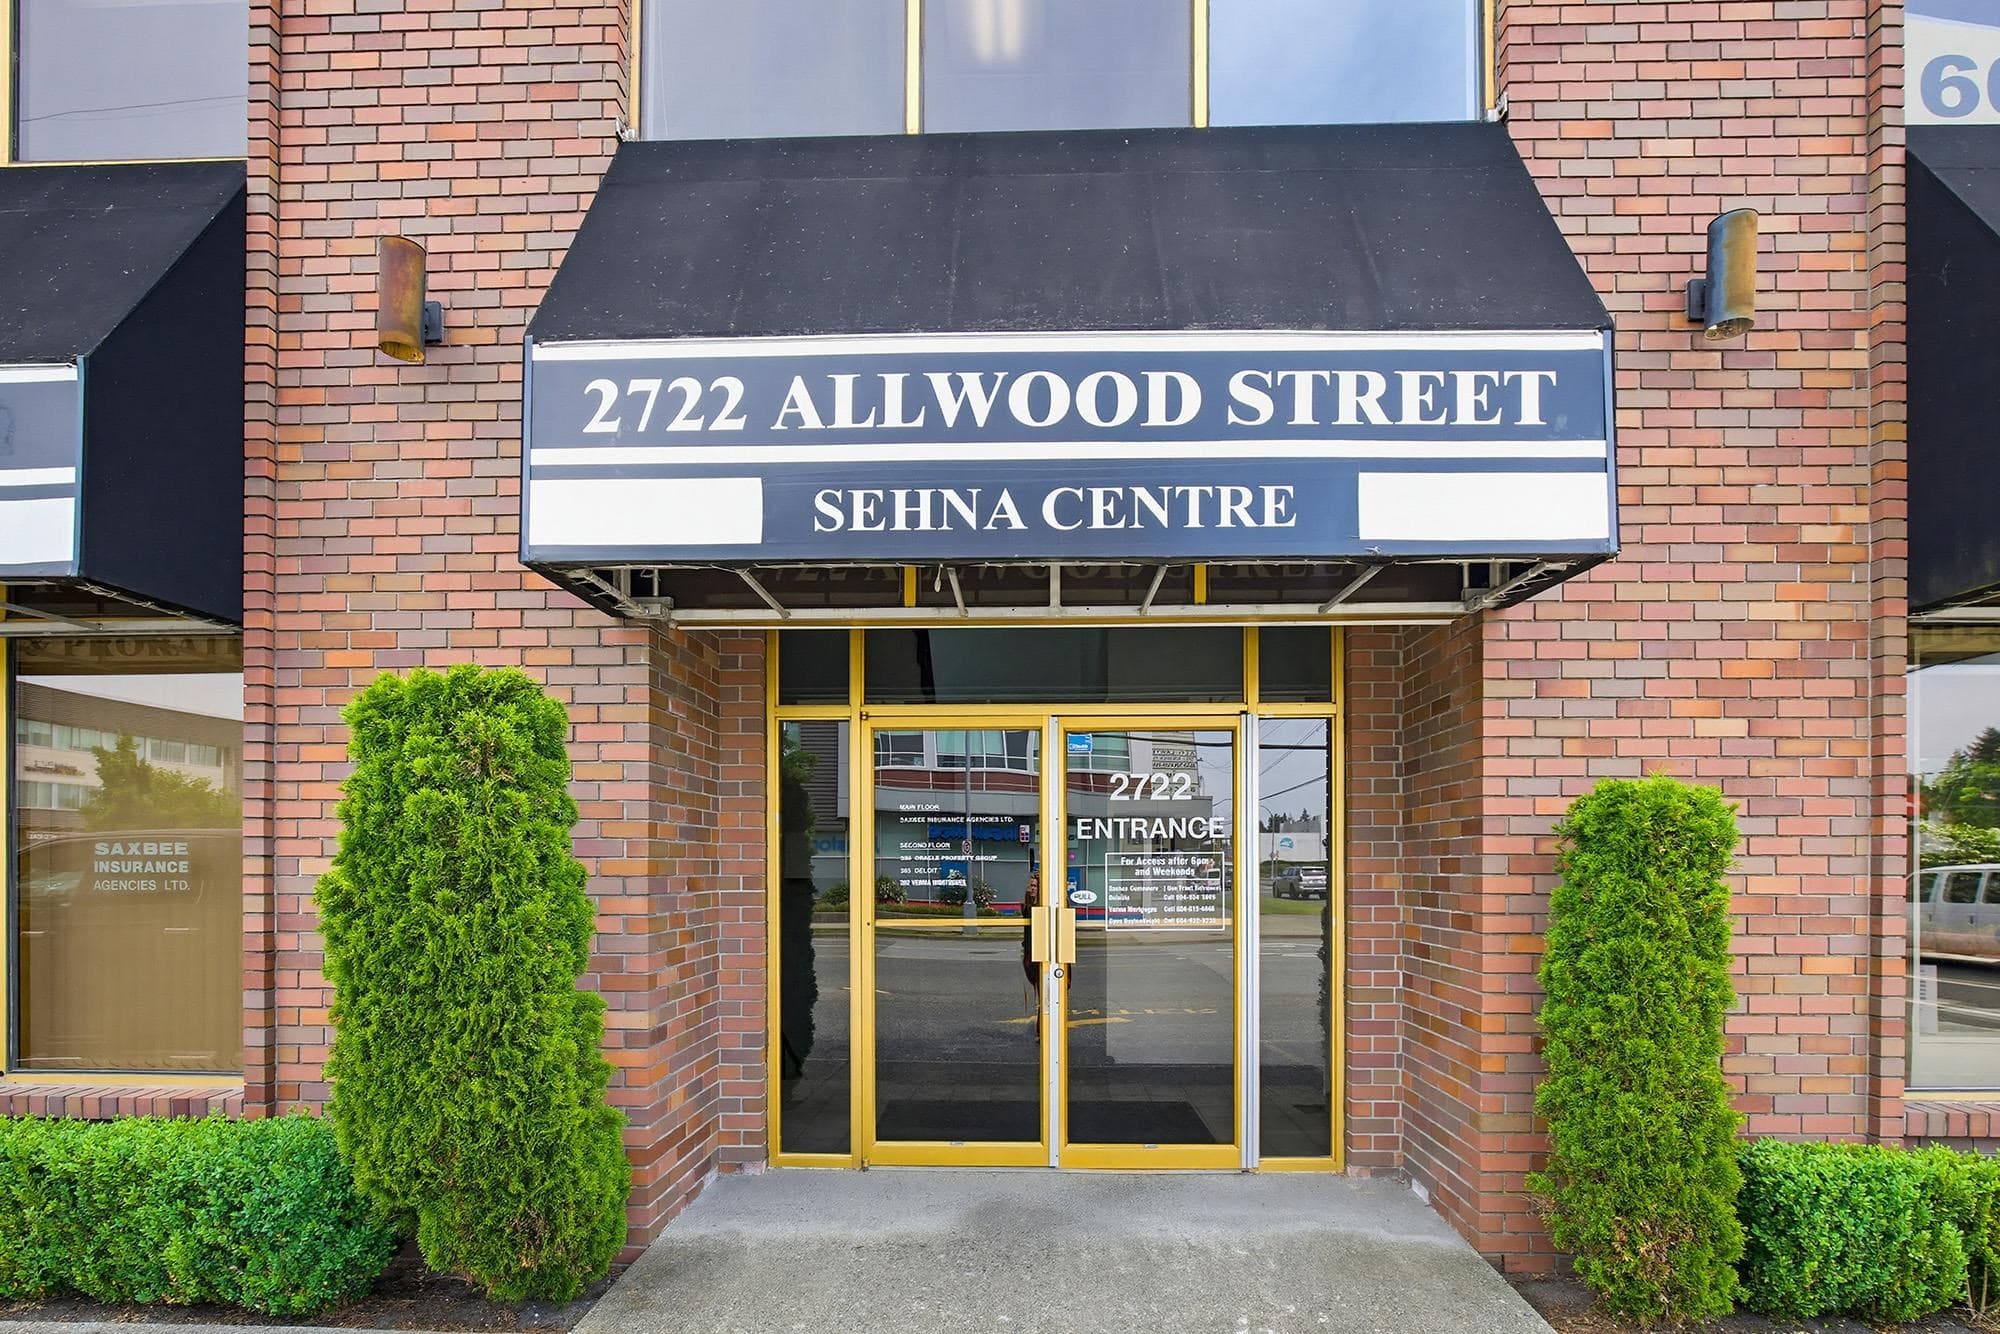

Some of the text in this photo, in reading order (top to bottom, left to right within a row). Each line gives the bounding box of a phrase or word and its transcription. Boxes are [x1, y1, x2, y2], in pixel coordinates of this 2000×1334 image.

[1920, 54, 2000, 117] 6
[583, 370, 1557, 434] 2722 ALLWOOD STREET
[814, 485, 1297, 533] SEHNA CENTRE
[1109, 773, 1193, 801] 2722
[1076, 816, 1225, 840] ENTRANCE
[95, 842, 189, 855] SAXBEE
[94, 861, 189, 873] INSURANCE
[1120, 857, 1134, 866] For
[1135, 856, 1166, 866] Access
[1168, 856, 1189, 866] after
[1135, 867, 1195, 876] and Weekends
[94, 880, 190, 890] AGENCIES LTD.
[1073, 892, 1092, 900] PULL
